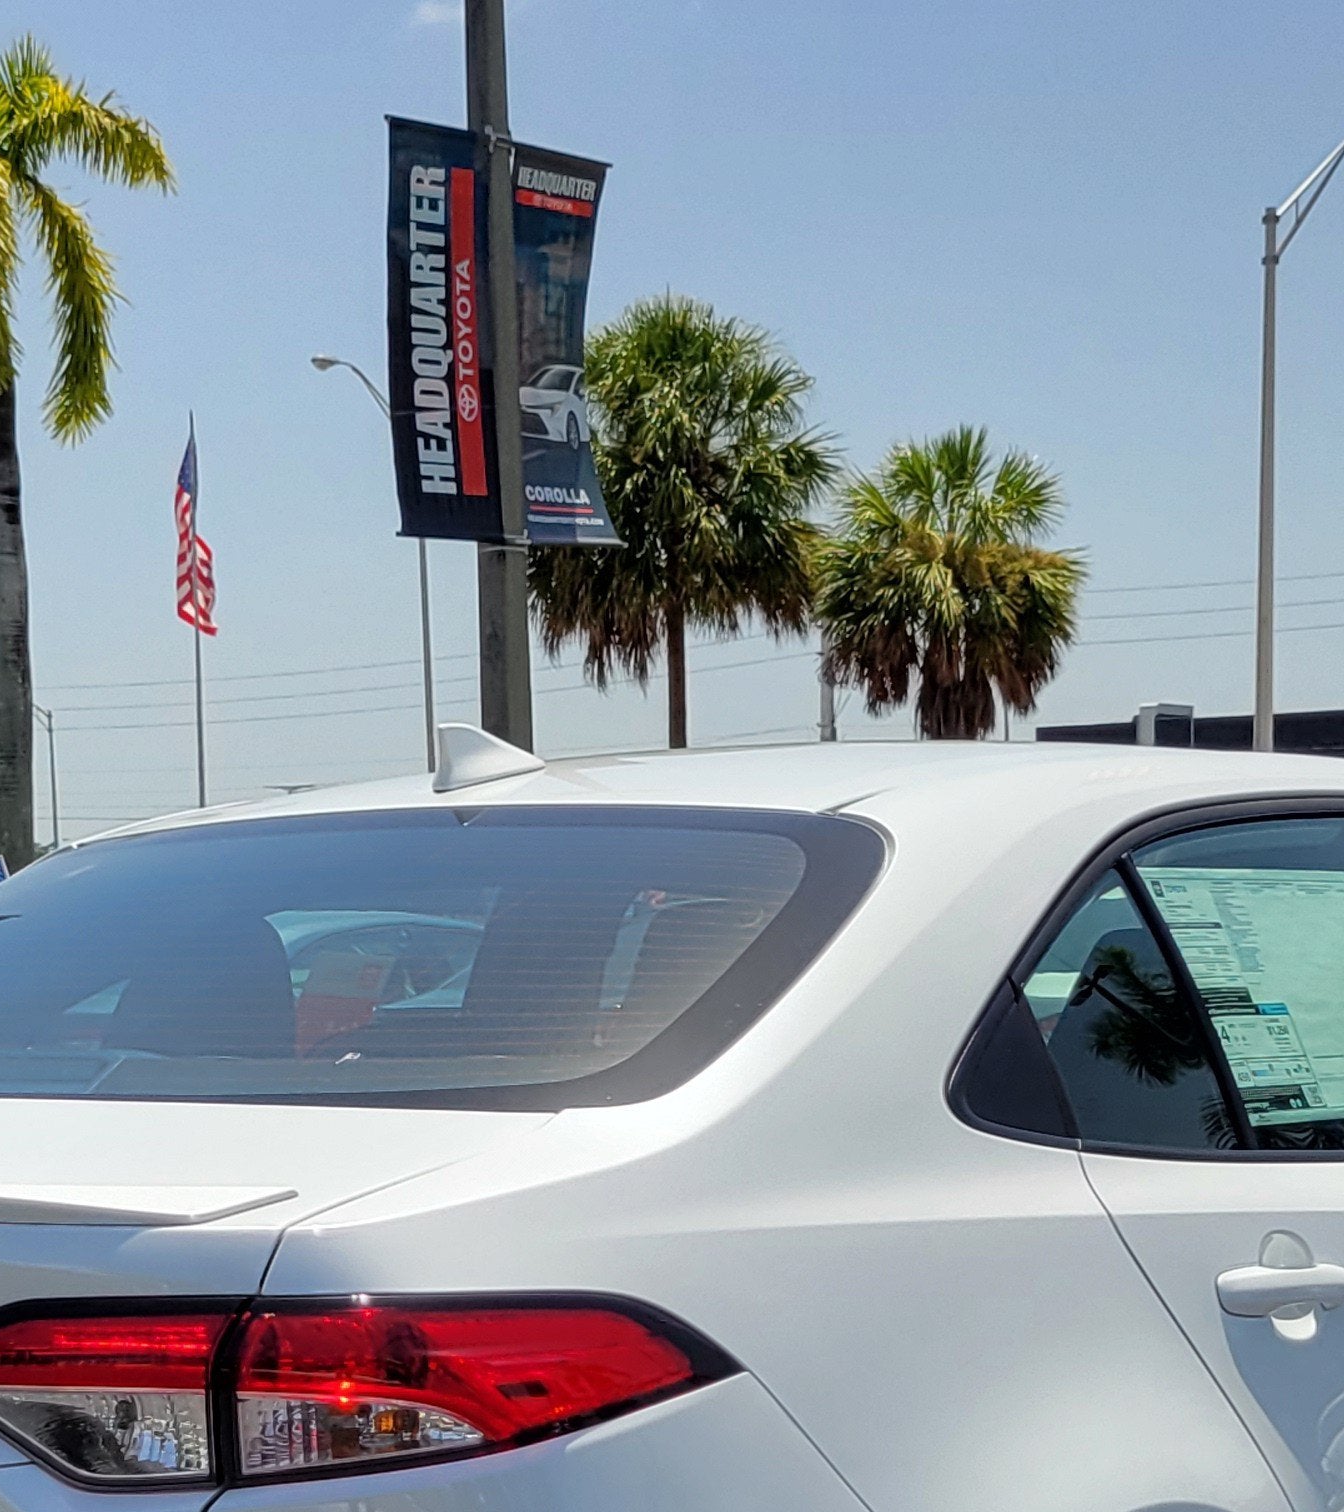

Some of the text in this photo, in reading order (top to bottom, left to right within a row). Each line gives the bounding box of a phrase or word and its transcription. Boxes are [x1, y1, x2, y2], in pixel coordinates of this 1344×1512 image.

[517, 166, 596, 202] HEADQUARTER
[409, 164, 457, 495] HEADQUARTER
[456, 259, 475, 381] TOYOTA
[524, 485, 591, 505] COROLLA
